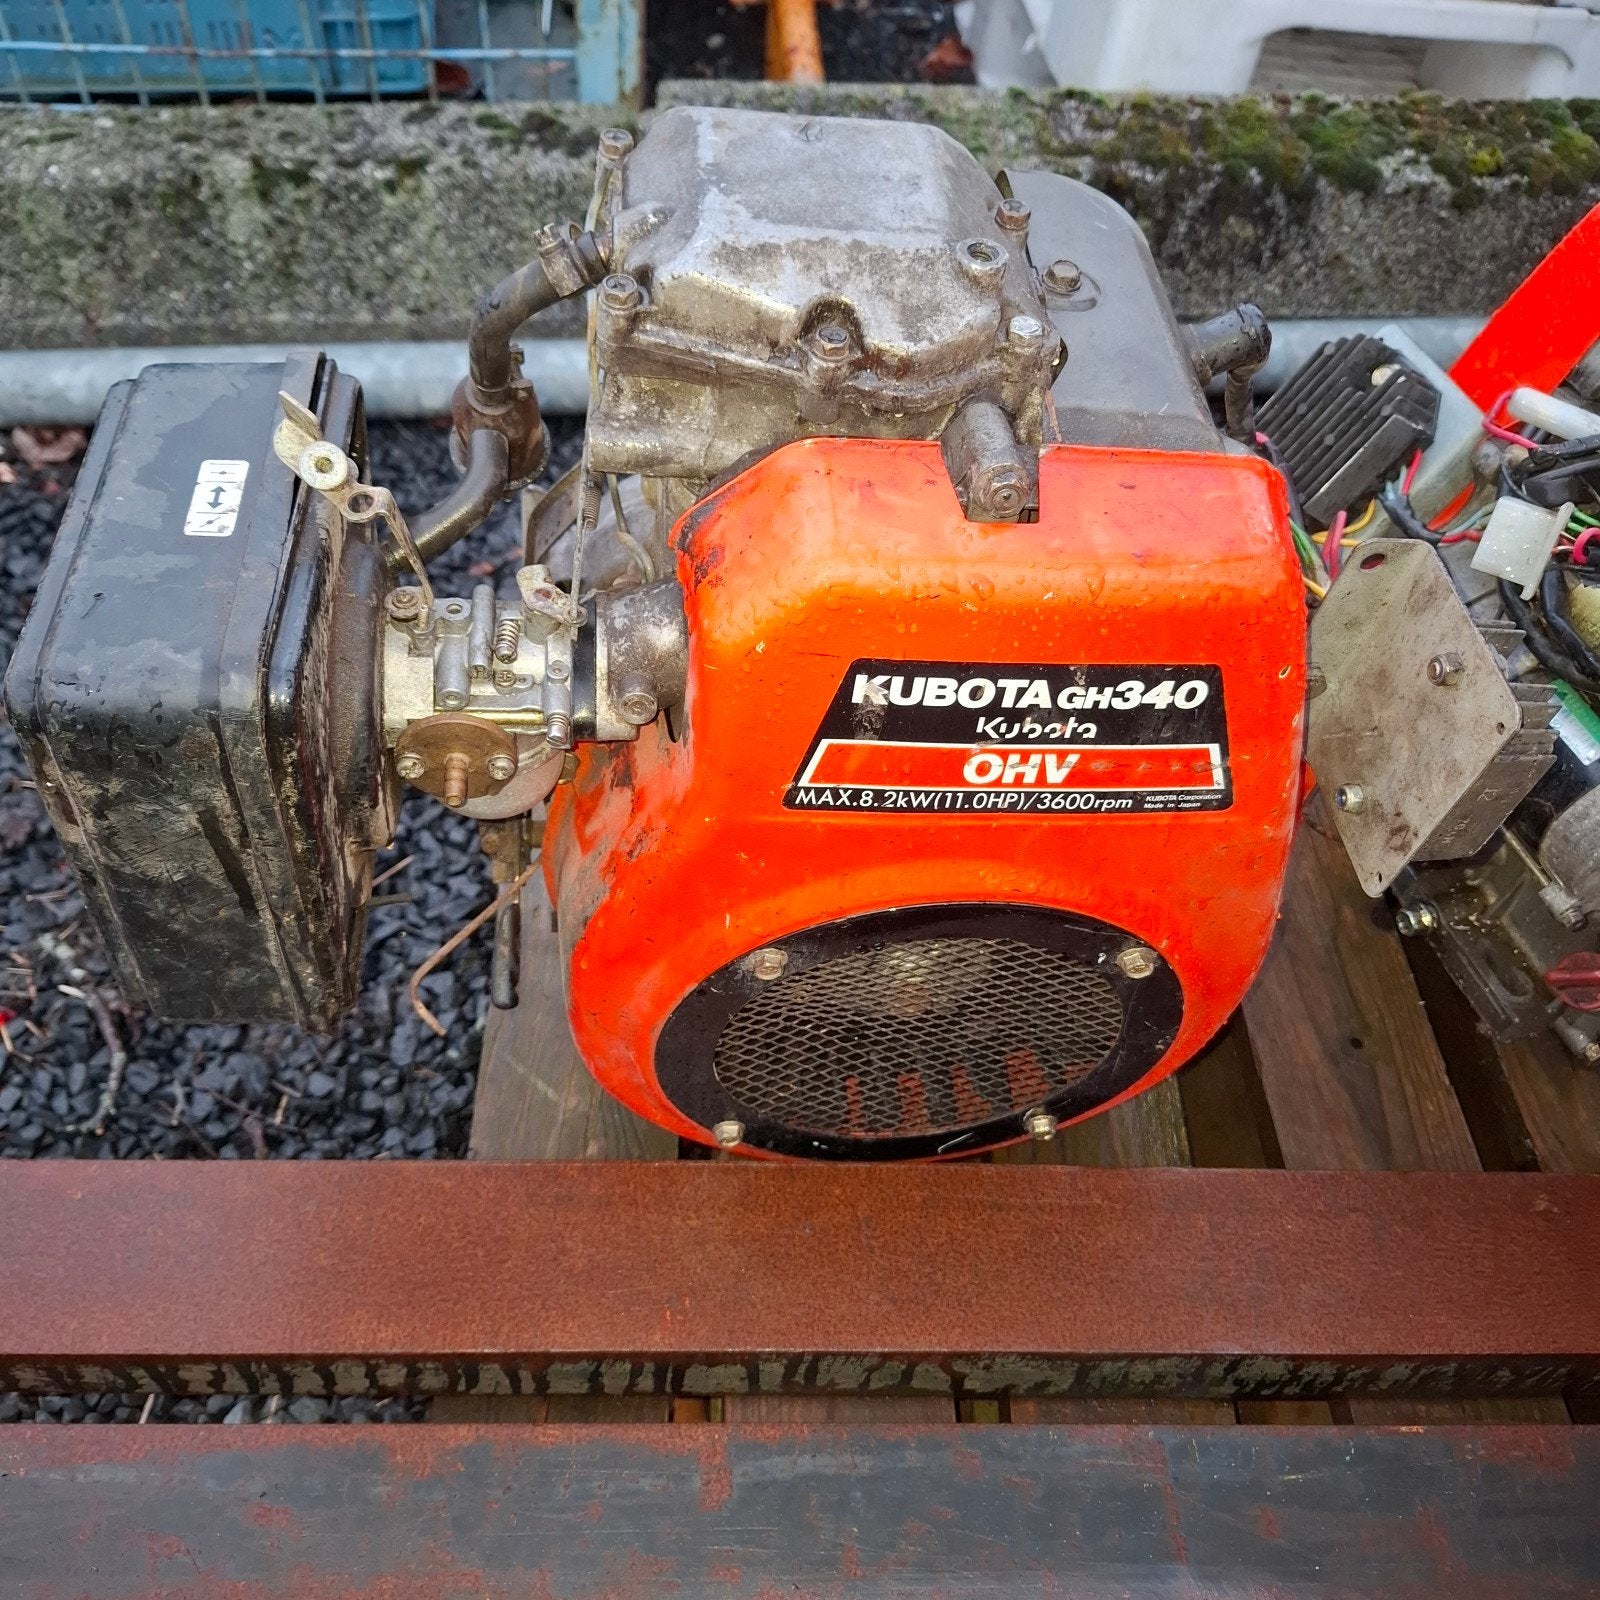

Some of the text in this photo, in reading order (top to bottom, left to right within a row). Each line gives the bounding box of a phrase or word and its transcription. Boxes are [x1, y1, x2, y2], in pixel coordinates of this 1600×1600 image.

[851, 674, 1209, 710] KUBOTA GH340
[976, 716, 1098, 739] Kubota
[962, 753, 1081, 784] OHV
[1145, 793, 1222, 802] KUBOTA Corporation
